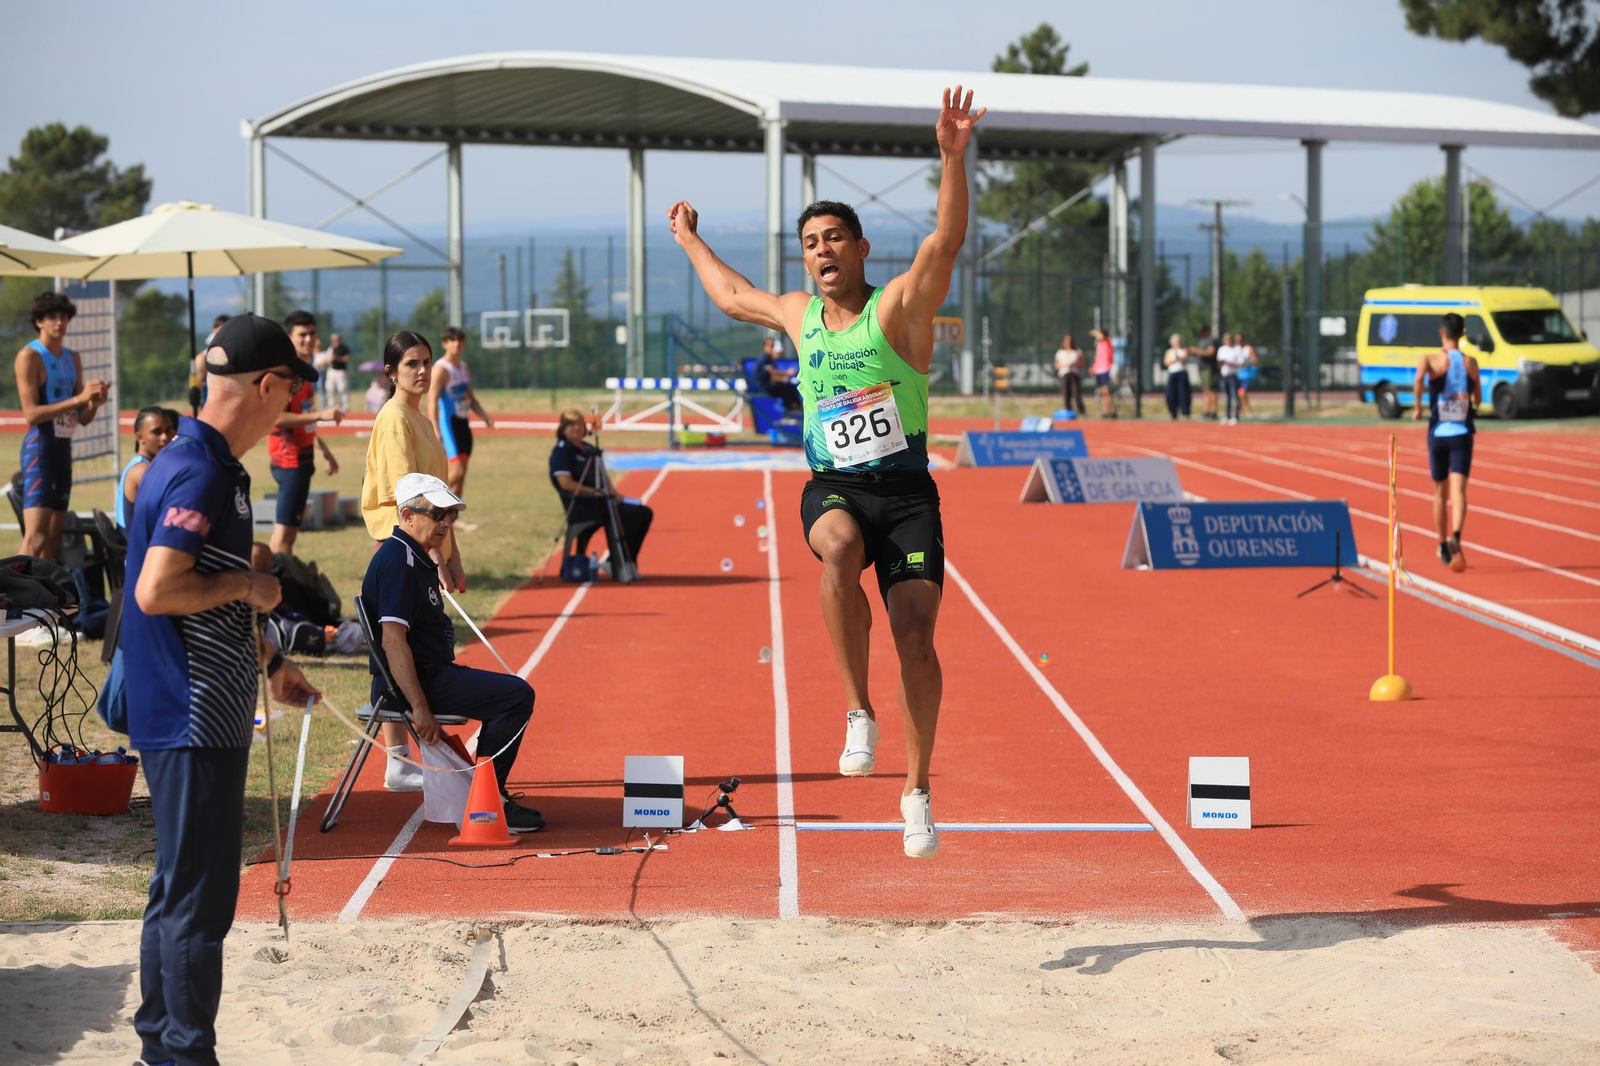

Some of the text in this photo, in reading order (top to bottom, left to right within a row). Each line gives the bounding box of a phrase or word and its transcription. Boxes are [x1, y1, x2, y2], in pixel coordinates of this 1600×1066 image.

[828, 348, 877, 361] Fundación
[829, 360, 865, 371] Unicaja
[843, 397, 863, 407] GALICIA
[863, 389, 889, 401] ABSOLUTO
[831, 407, 891, 449] 326
[1081, 461, 1137, 478] XUNTA
[1087, 480, 1176, 499] DE GALICIA
[1203, 509, 1325, 534] DEPUTACIÓN
[1208, 538, 1298, 558] OURENSE
